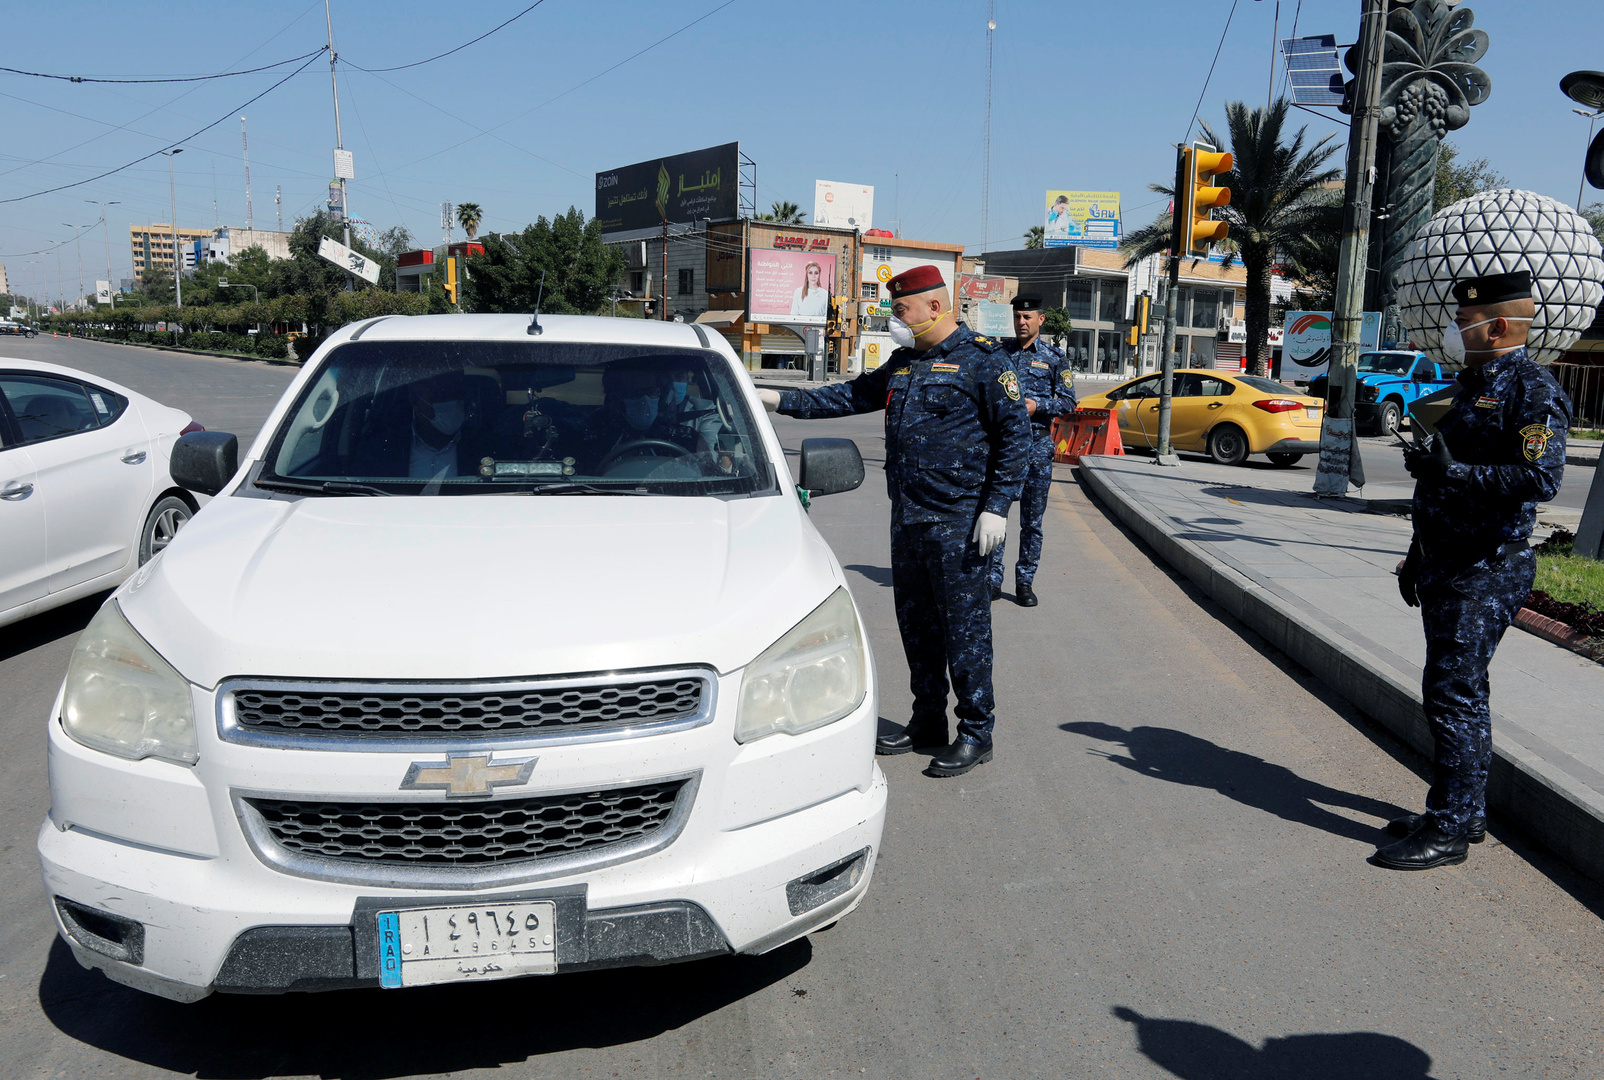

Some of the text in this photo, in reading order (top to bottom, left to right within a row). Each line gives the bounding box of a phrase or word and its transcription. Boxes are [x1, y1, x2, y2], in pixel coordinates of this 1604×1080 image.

[774, 232, 830, 250] لحم بعجين
[457, 961, 504, 977] حكومية
